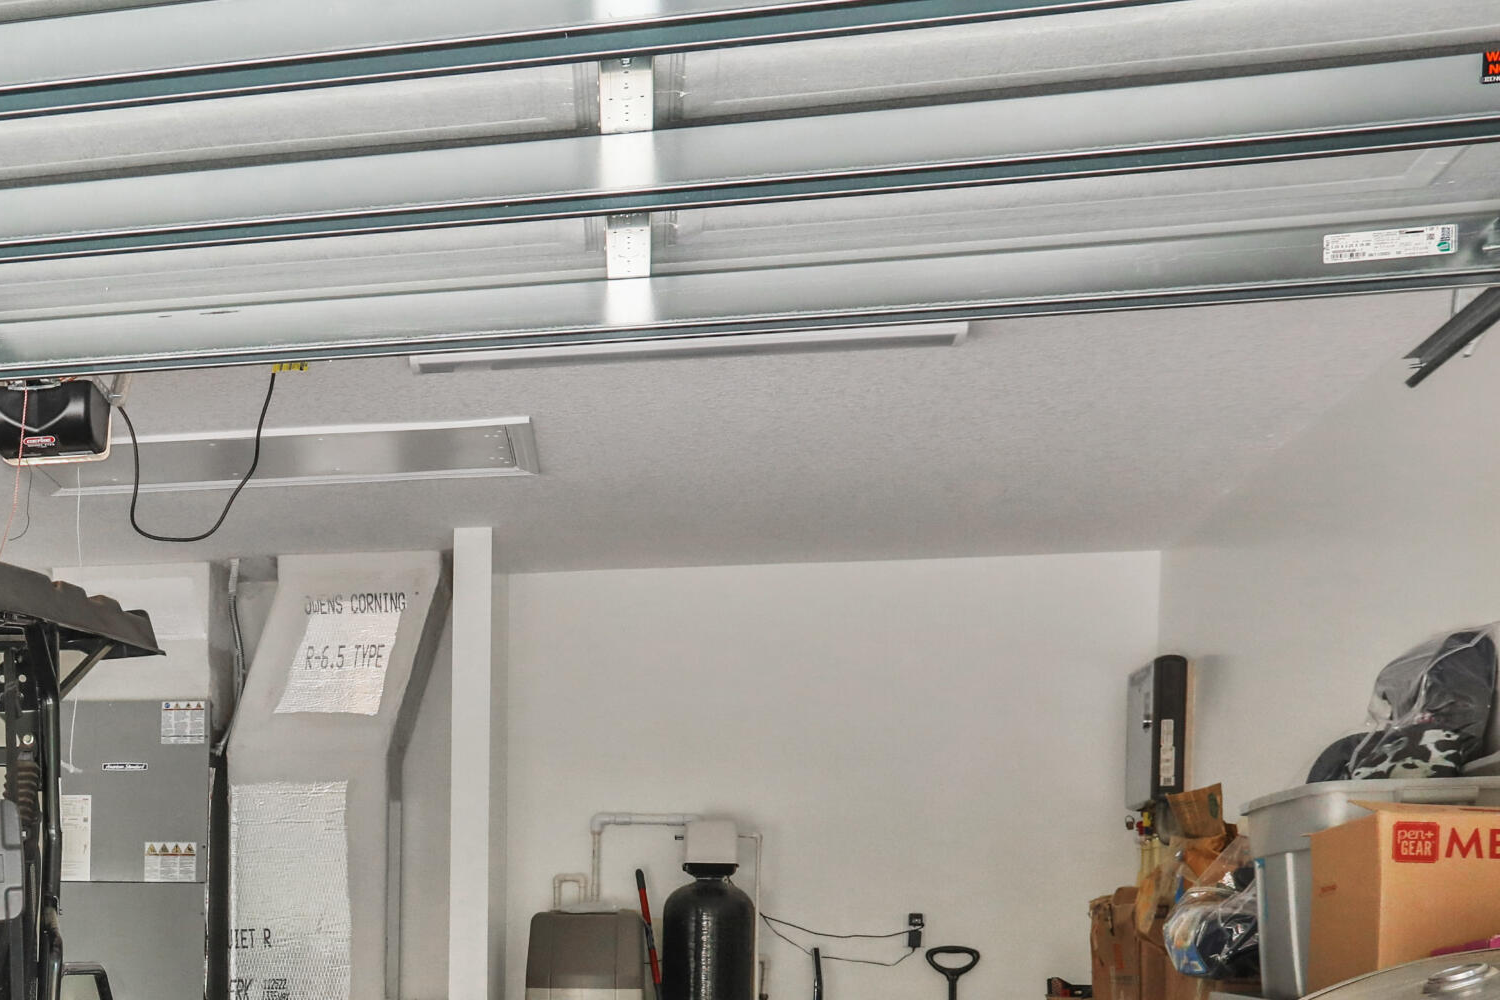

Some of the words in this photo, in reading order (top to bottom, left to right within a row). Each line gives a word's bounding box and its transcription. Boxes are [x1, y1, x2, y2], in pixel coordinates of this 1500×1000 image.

[304, 595, 344, 615] OWENS
[350, 592, 406, 614] CORNING
[304, 645, 345, 670] R-6.5
[353, 644, 385, 668] TYPE
[1397, 829, 1435, 844] pen+
[1401, 840, 1432, 856] GEAR
